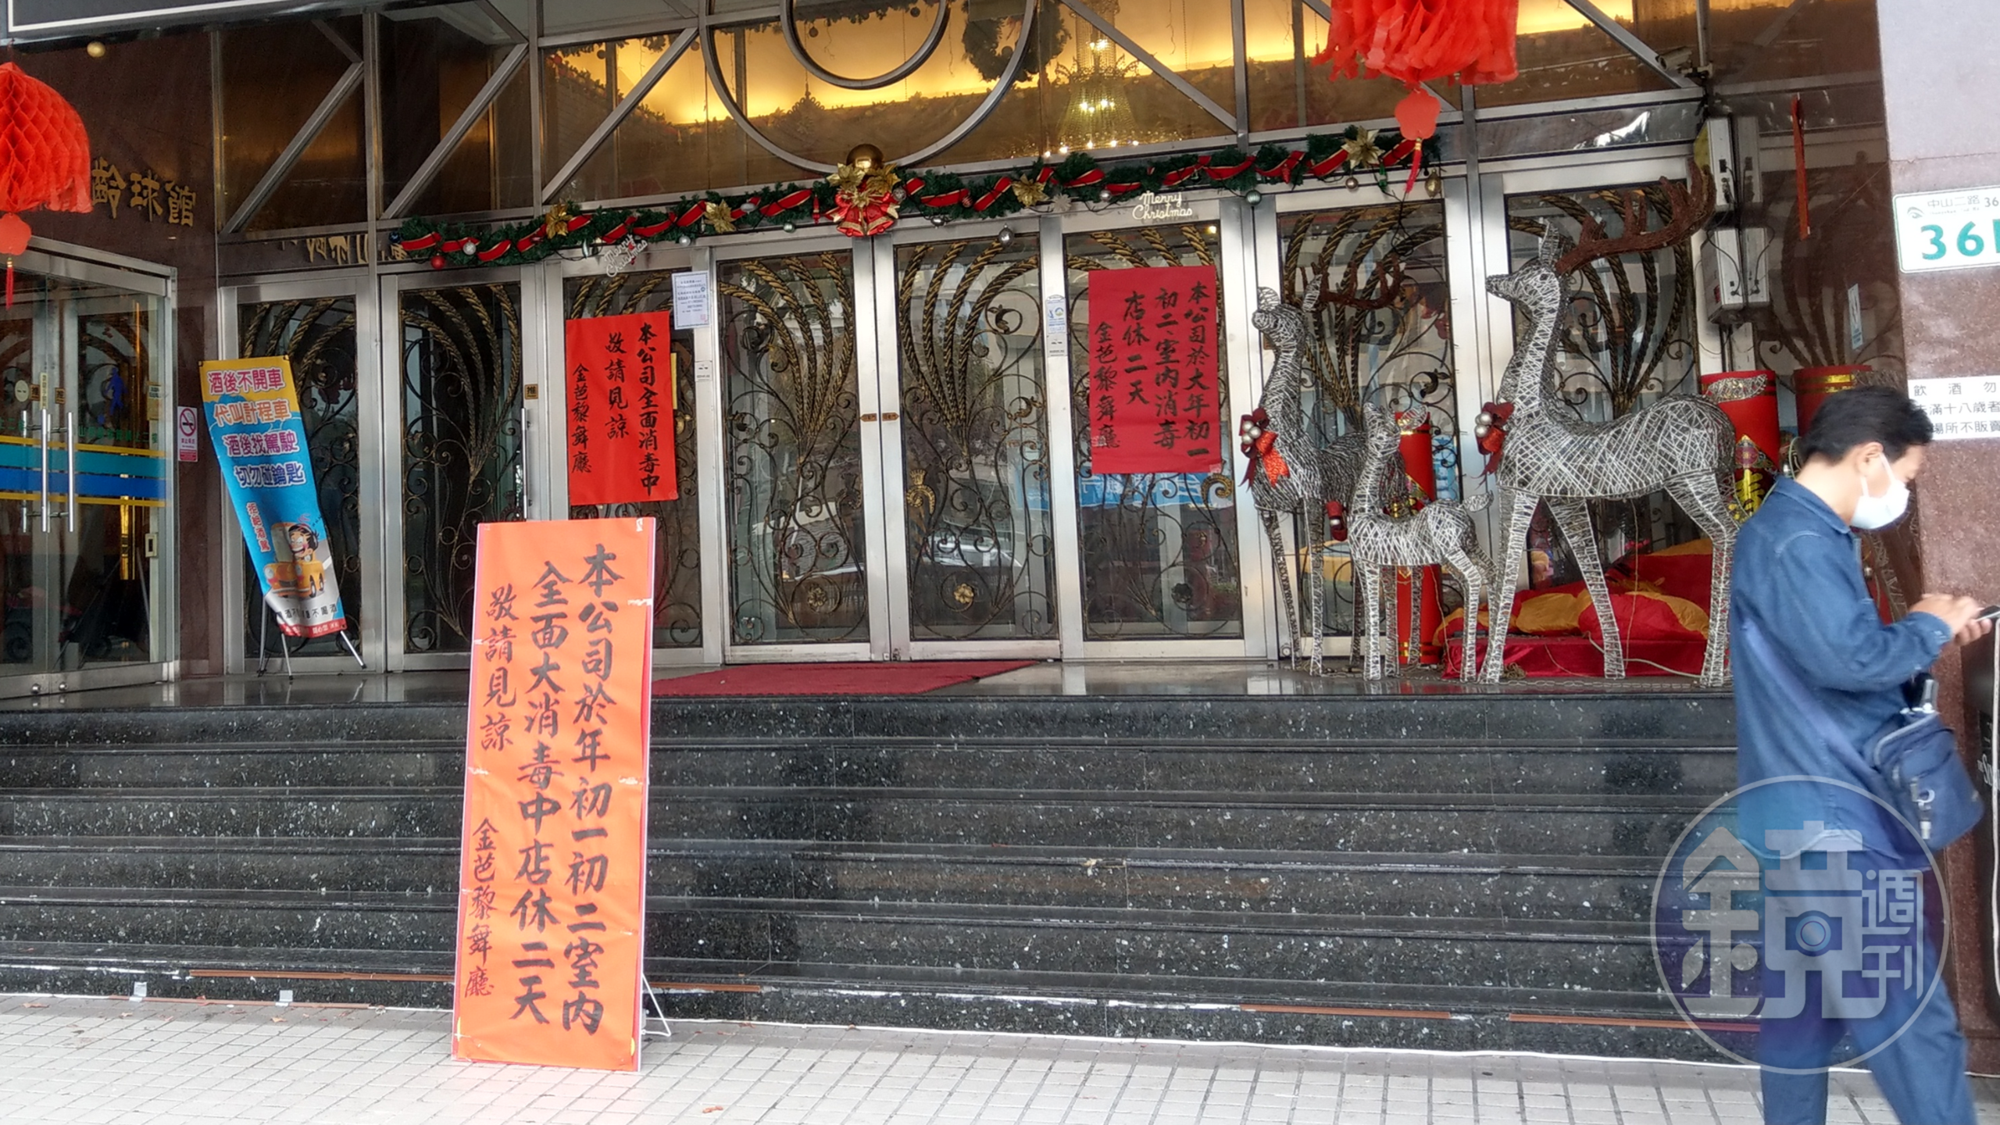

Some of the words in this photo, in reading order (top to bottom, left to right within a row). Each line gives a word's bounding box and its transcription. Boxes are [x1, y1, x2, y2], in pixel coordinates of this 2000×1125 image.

[1132, 203, 1193, 219] Christmas
[1140, 190, 1182, 207] Merry
[1927, 194, 1980, 208] 中山二路
[207, 367, 286, 395] 酒後不開車
[604, 332, 629, 439] 敬請見諒
[1093, 321, 1121, 449] 金芭黎舞廳
[1122, 291, 1150, 405] 店休二天
[1184, 281, 1211, 457] 本公司於大年初一
[213, 399, 292, 427] 代叫計程車
[222, 430, 299, 457] 酒後找駕駛
[571, 363, 592, 474] 金芭黎舞廳
[636, 322, 660, 496] 本公司全面消毒中
[234, 462, 306, 487] 切勿碰鑰匙
[480, 583, 519, 752] 敬請見諒
[509, 561, 574, 1025] 全面大消毒中店休二天
[562, 543, 625, 1035] 本公司於年初一初二室內
[464, 818, 499, 998] 金芭黎舞廳
